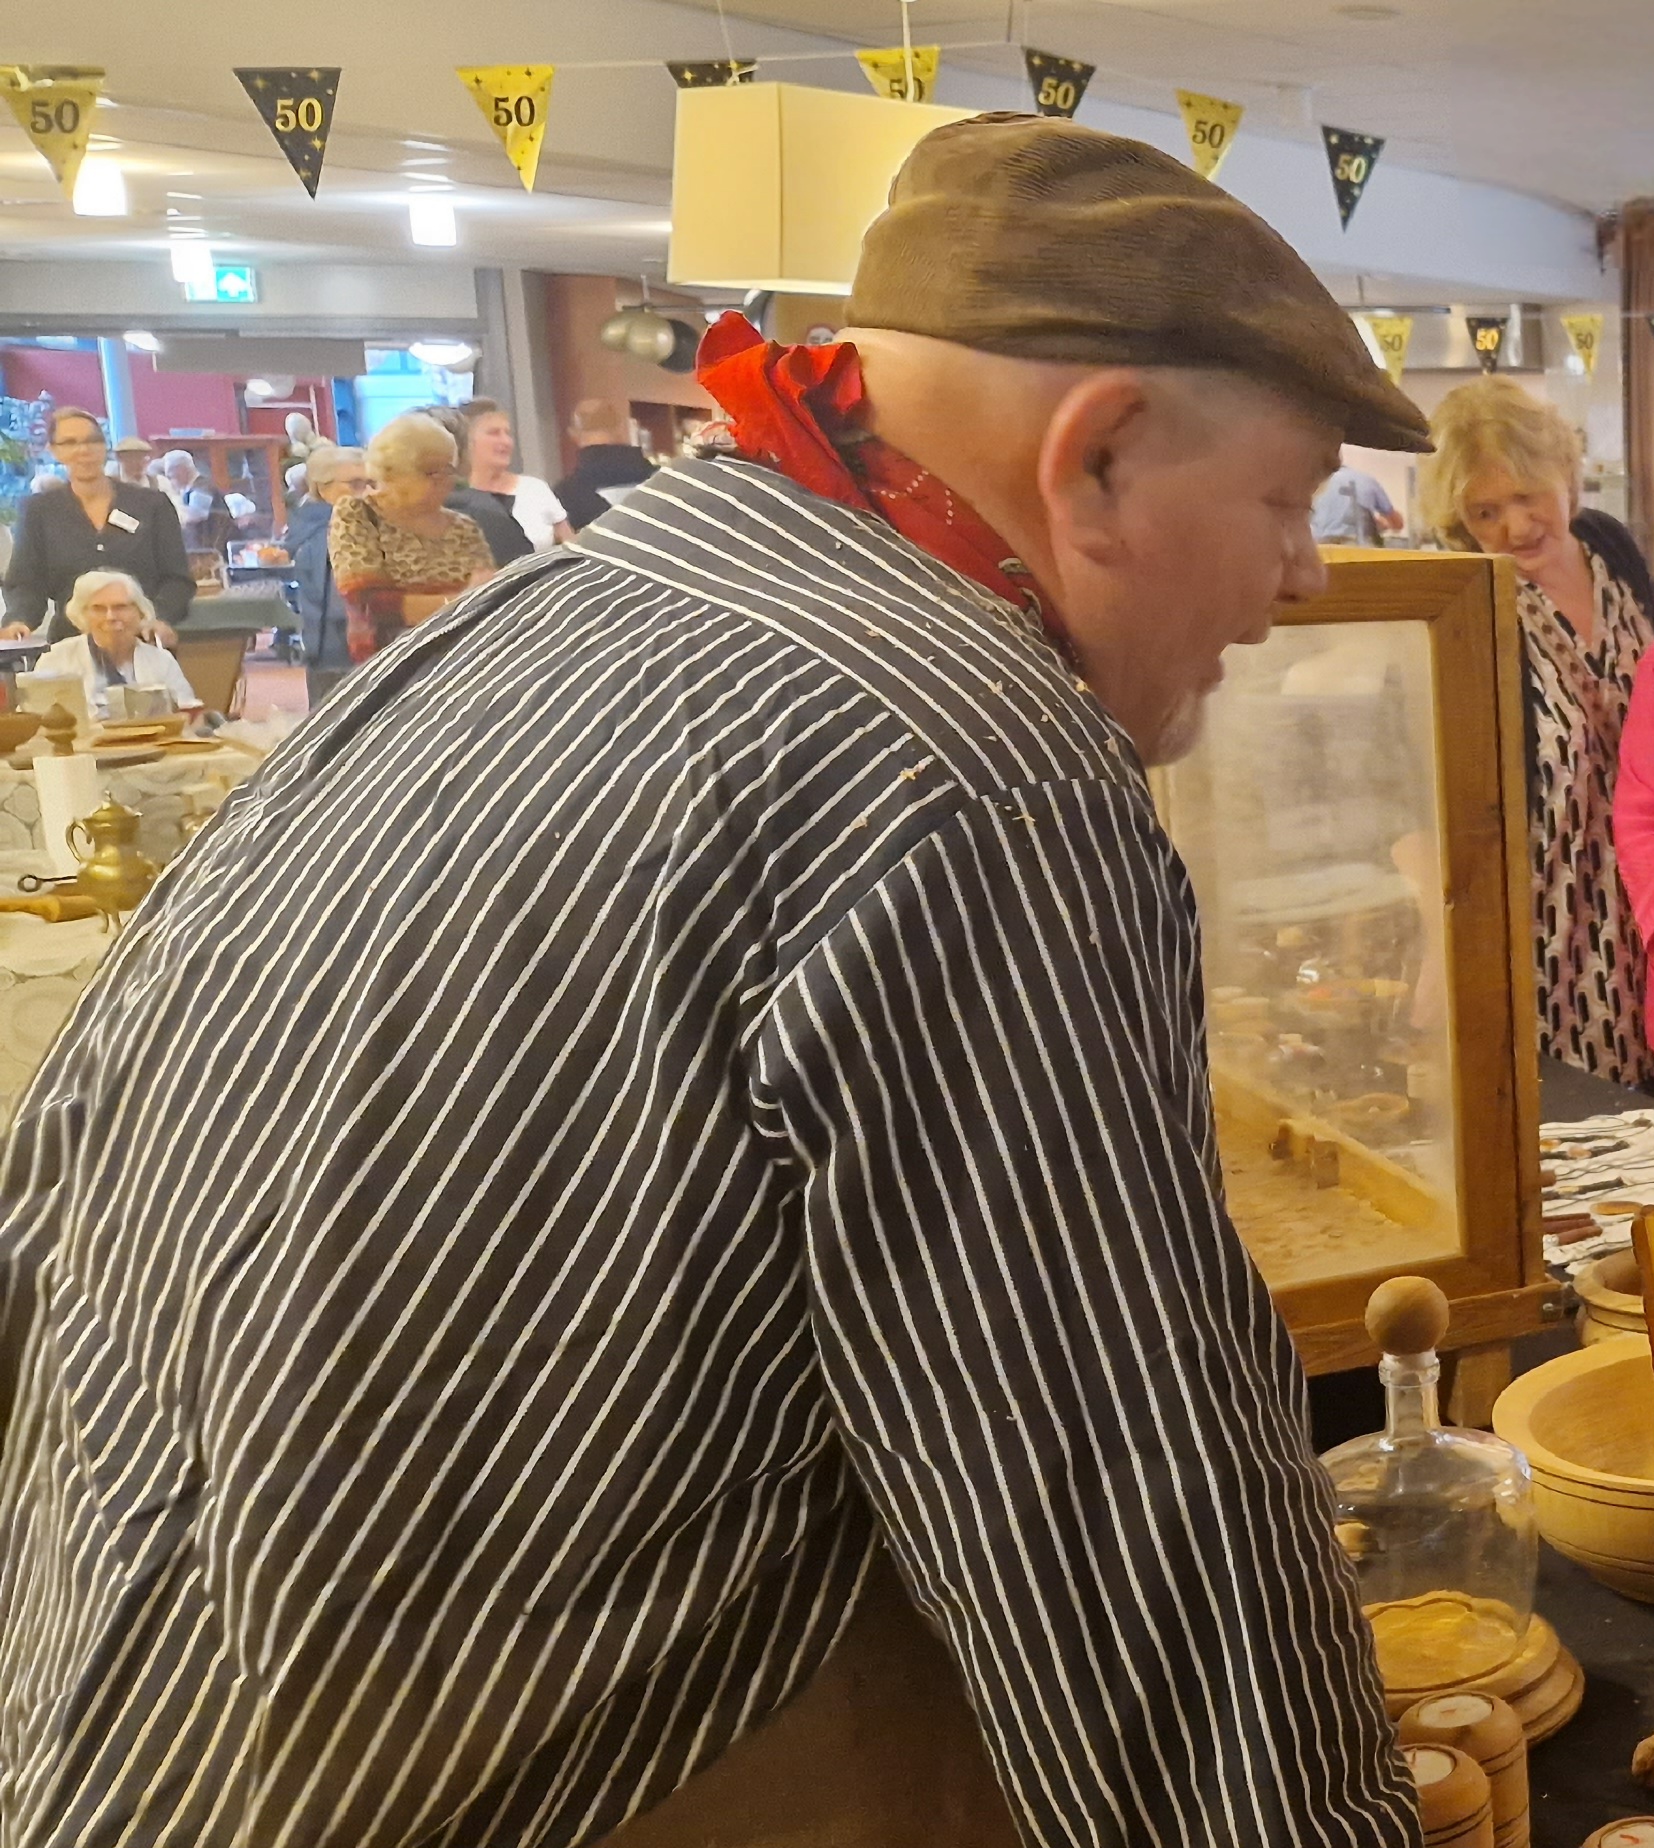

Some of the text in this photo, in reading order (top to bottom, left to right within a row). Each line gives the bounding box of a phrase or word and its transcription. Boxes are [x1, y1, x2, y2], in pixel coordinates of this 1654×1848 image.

[1038, 76, 1076, 110] 50
[29, 98, 80, 134] 50
[274, 97, 323, 133] 50
[493, 95, 535, 127] 50
[1191, 120, 1225, 149] 50
[1334, 153, 1366, 184] 50
[1475, 328, 1499, 350] 50
[1575, 332, 1595, 350] 50
